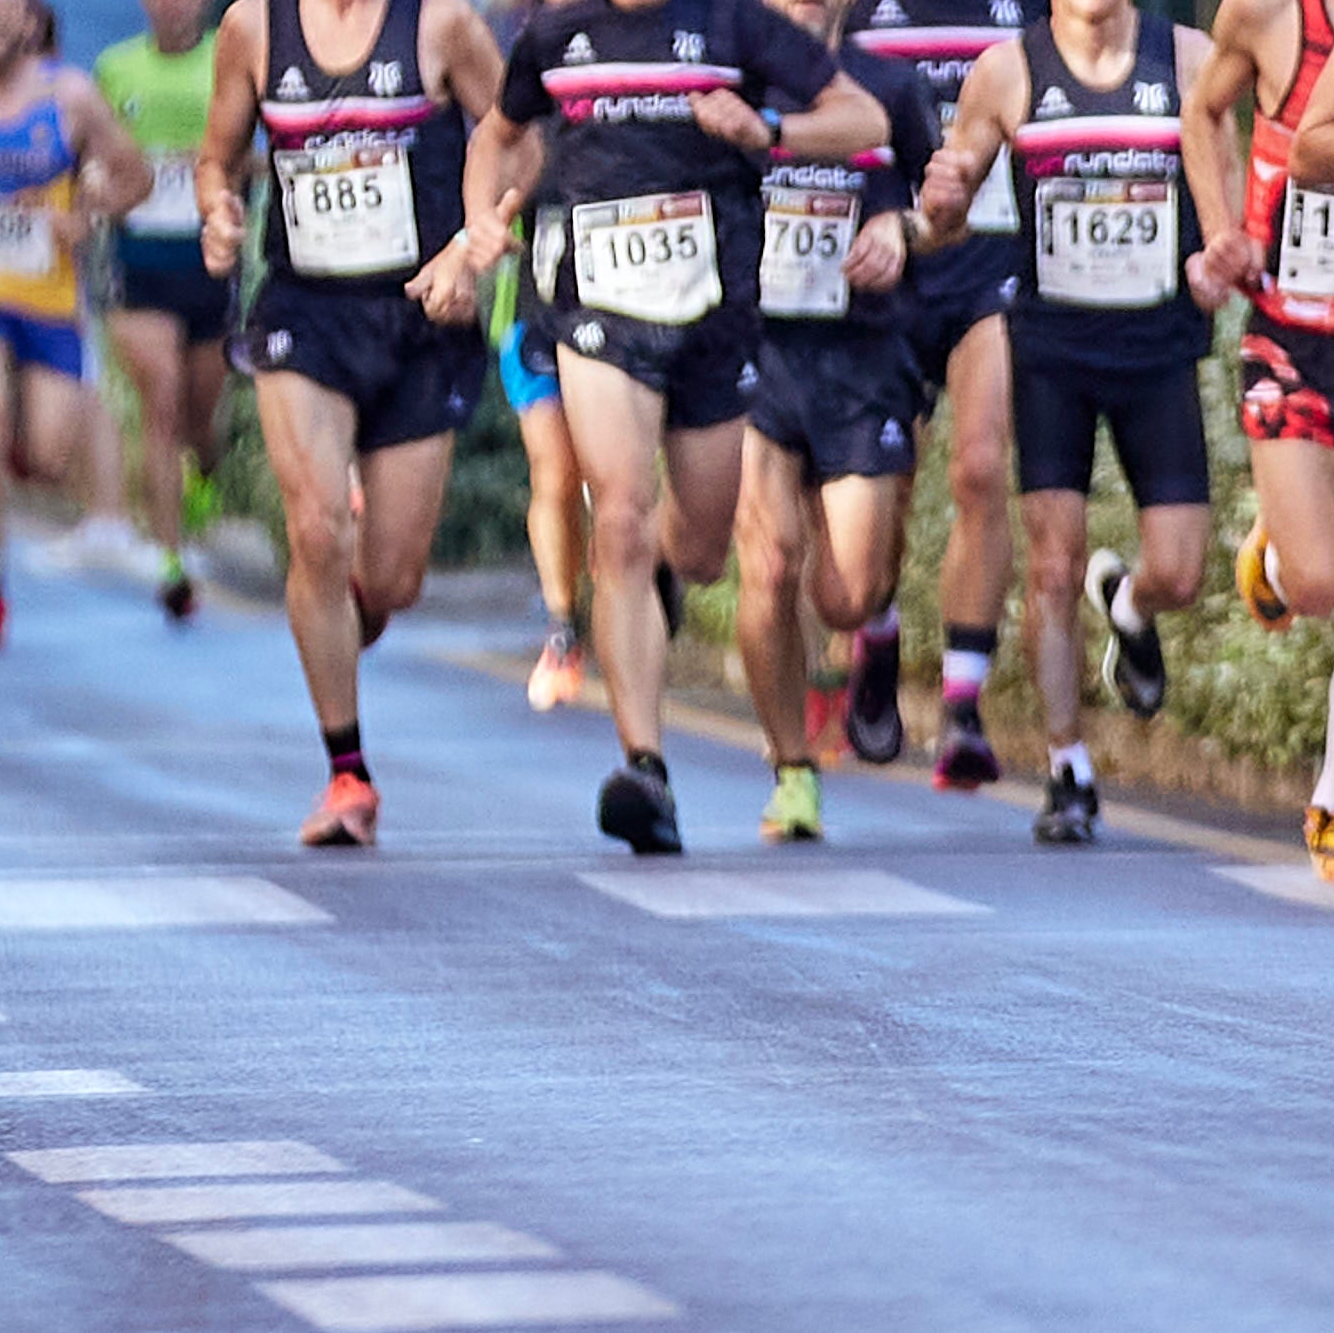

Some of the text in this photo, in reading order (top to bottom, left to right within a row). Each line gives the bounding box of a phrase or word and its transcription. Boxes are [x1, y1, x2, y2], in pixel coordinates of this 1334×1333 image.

[313, 173, 382, 214] 885
[602, 224, 698, 269] 1035
[773, 218, 838, 261] 705
[1063, 206, 1158, 245] 1629
